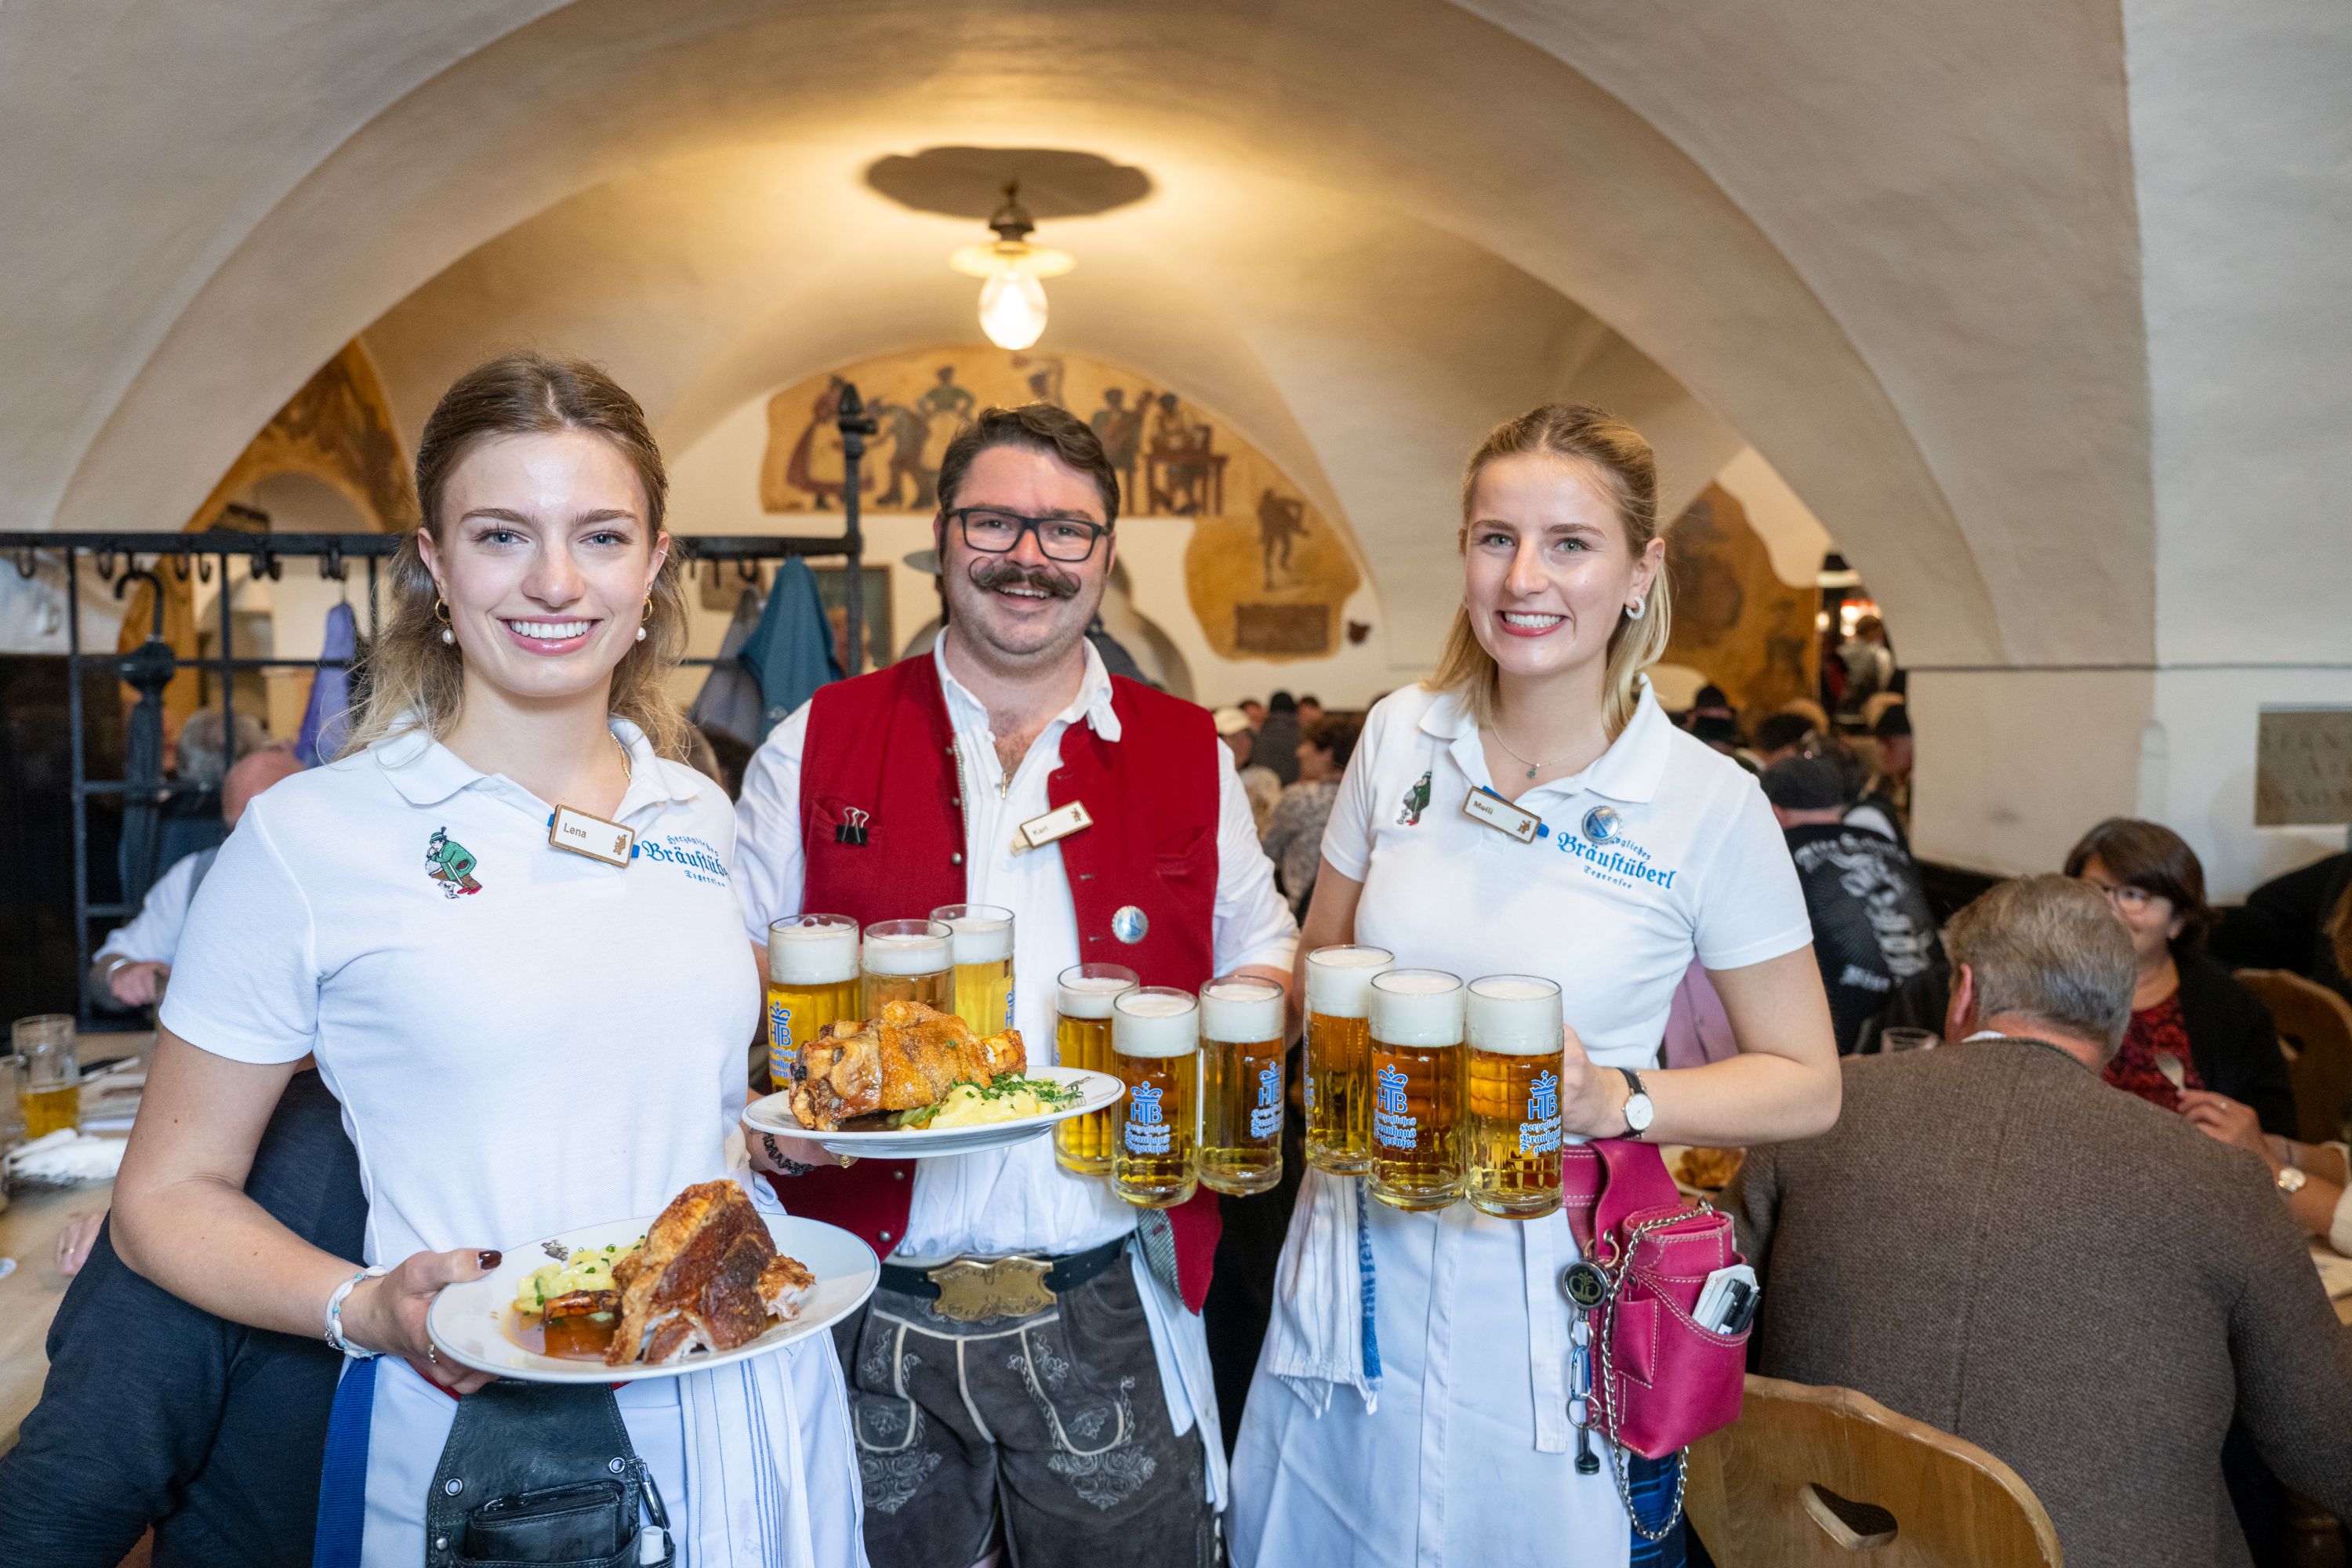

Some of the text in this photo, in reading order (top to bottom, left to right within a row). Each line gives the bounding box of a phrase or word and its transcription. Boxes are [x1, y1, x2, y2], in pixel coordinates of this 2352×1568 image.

[563, 823, 587, 839] Lena
[770, 1020, 792, 1047] HTB
[1377, 1083, 1409, 1115] HTB
[1528, 1091, 1559, 1122] HTB
[1131, 1100, 1163, 1126] HTB
